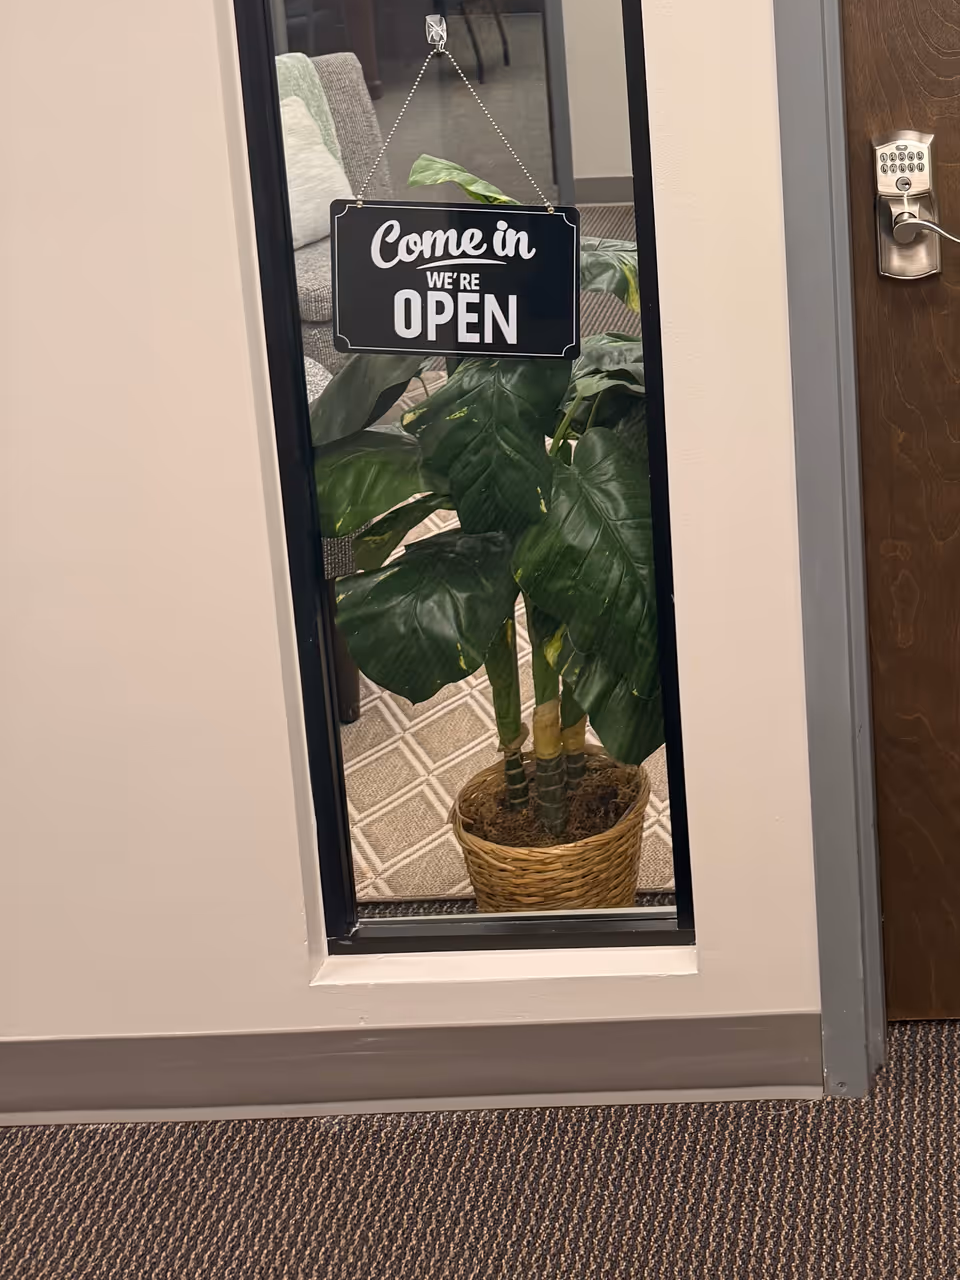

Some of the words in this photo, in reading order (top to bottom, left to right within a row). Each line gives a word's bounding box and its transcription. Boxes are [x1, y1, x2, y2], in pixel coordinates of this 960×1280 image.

[371, 220, 487, 269] Come
[493, 220, 536, 260] in
[426, 271, 480, 290] WE'RE
[394, 288, 518, 344] OPEN
